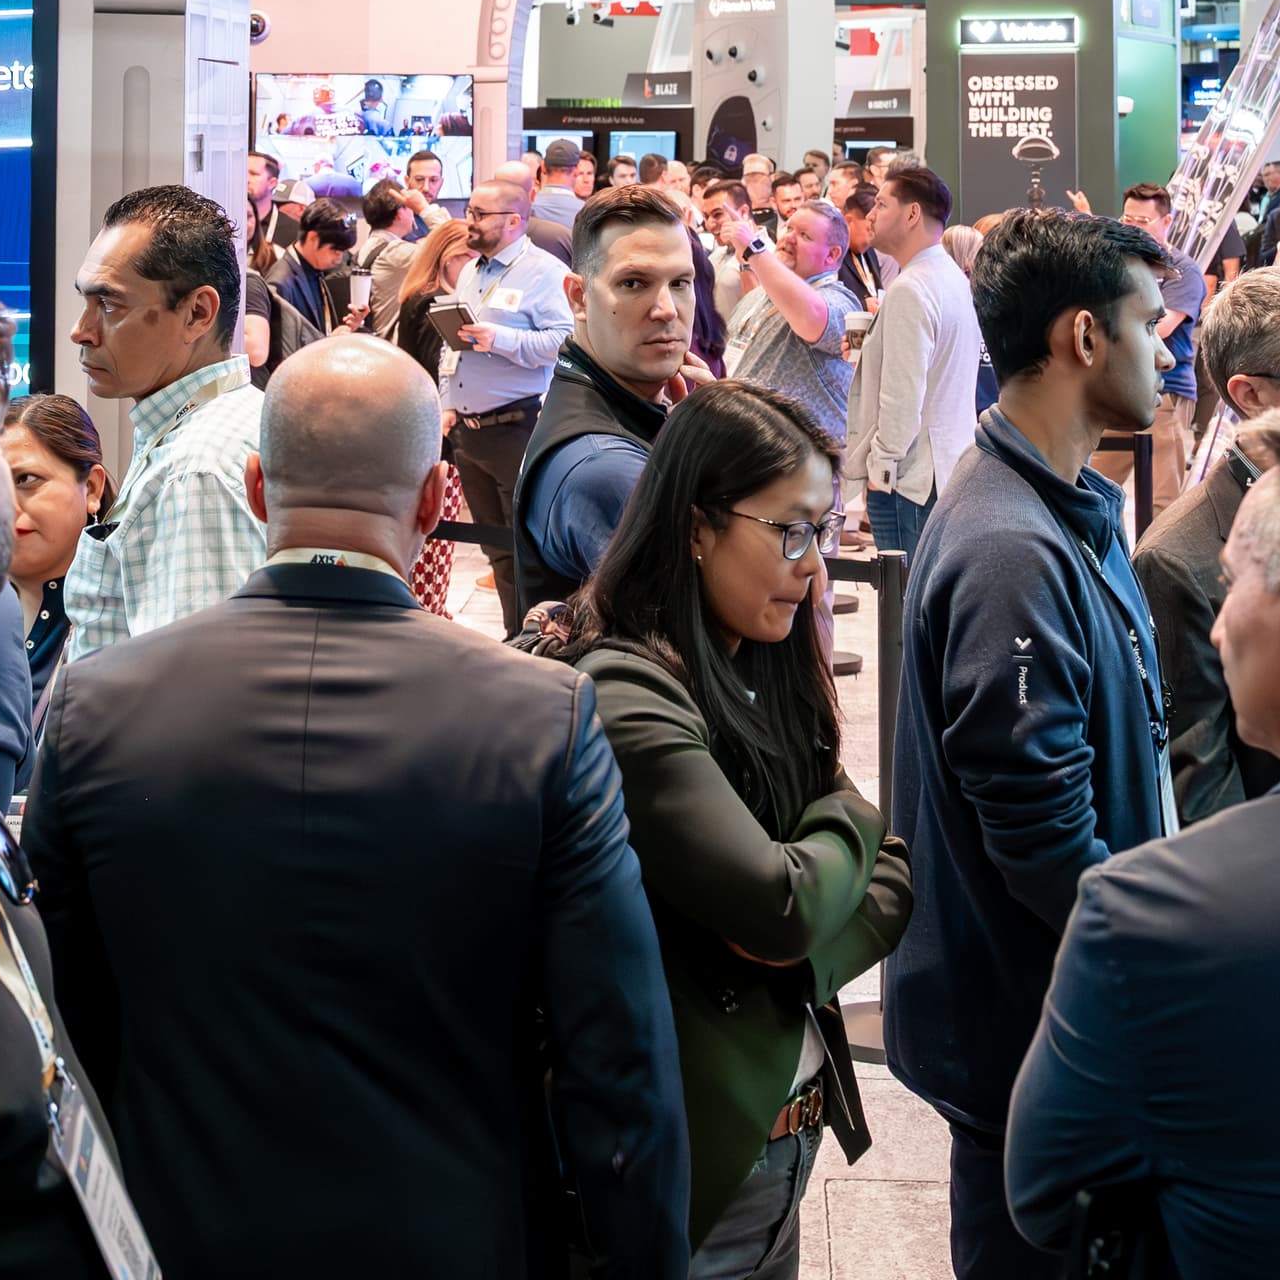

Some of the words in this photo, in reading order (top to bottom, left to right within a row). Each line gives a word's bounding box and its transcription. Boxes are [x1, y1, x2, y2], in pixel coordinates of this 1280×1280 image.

[655, 83, 679, 96] BLAZE
[967, 75, 1059, 91] OBSESSED
[967, 91, 1015, 107] WITH
[968, 107, 1053, 122] BUILDING
[967, 122, 1004, 138] THE
[1006, 122, 1054, 138] BEST.
[310, 553, 337, 566] AXIS
[1018, 665, 1029, 706] Product
